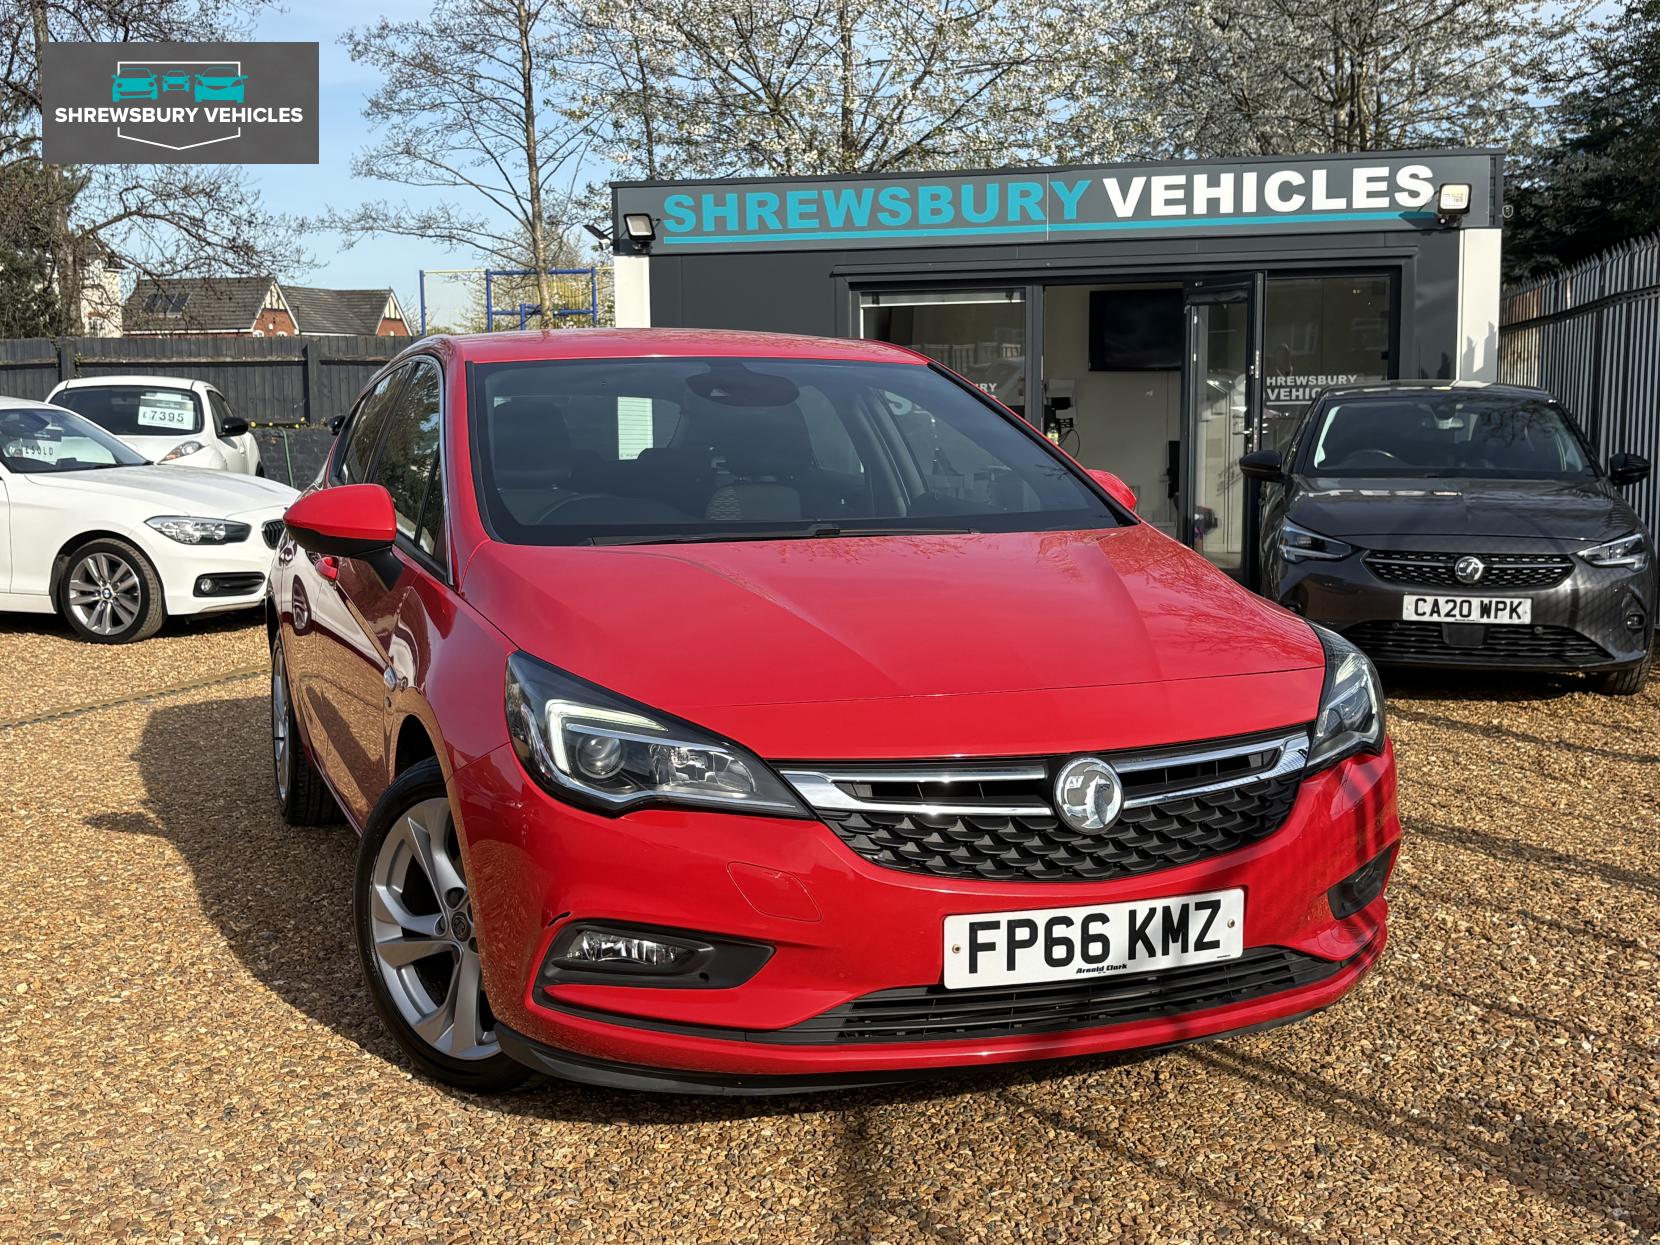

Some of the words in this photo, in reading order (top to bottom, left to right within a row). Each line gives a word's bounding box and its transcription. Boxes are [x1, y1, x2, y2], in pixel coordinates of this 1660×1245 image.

[663, 179, 1091, 234] SHREWSBURY
[1102, 164, 1435, 218] VEHICLES
[1266, 387, 1322, 401] VEHIC
[1413, 597, 1473, 619] CA20
[1479, 599, 1523, 620] WPK
[968, 912, 1112, 975] FP66
[1127, 899, 1222, 961] KMZ
[1075, 965, 1105, 974] Arnold
[1106, 963, 1128, 971] Clark
